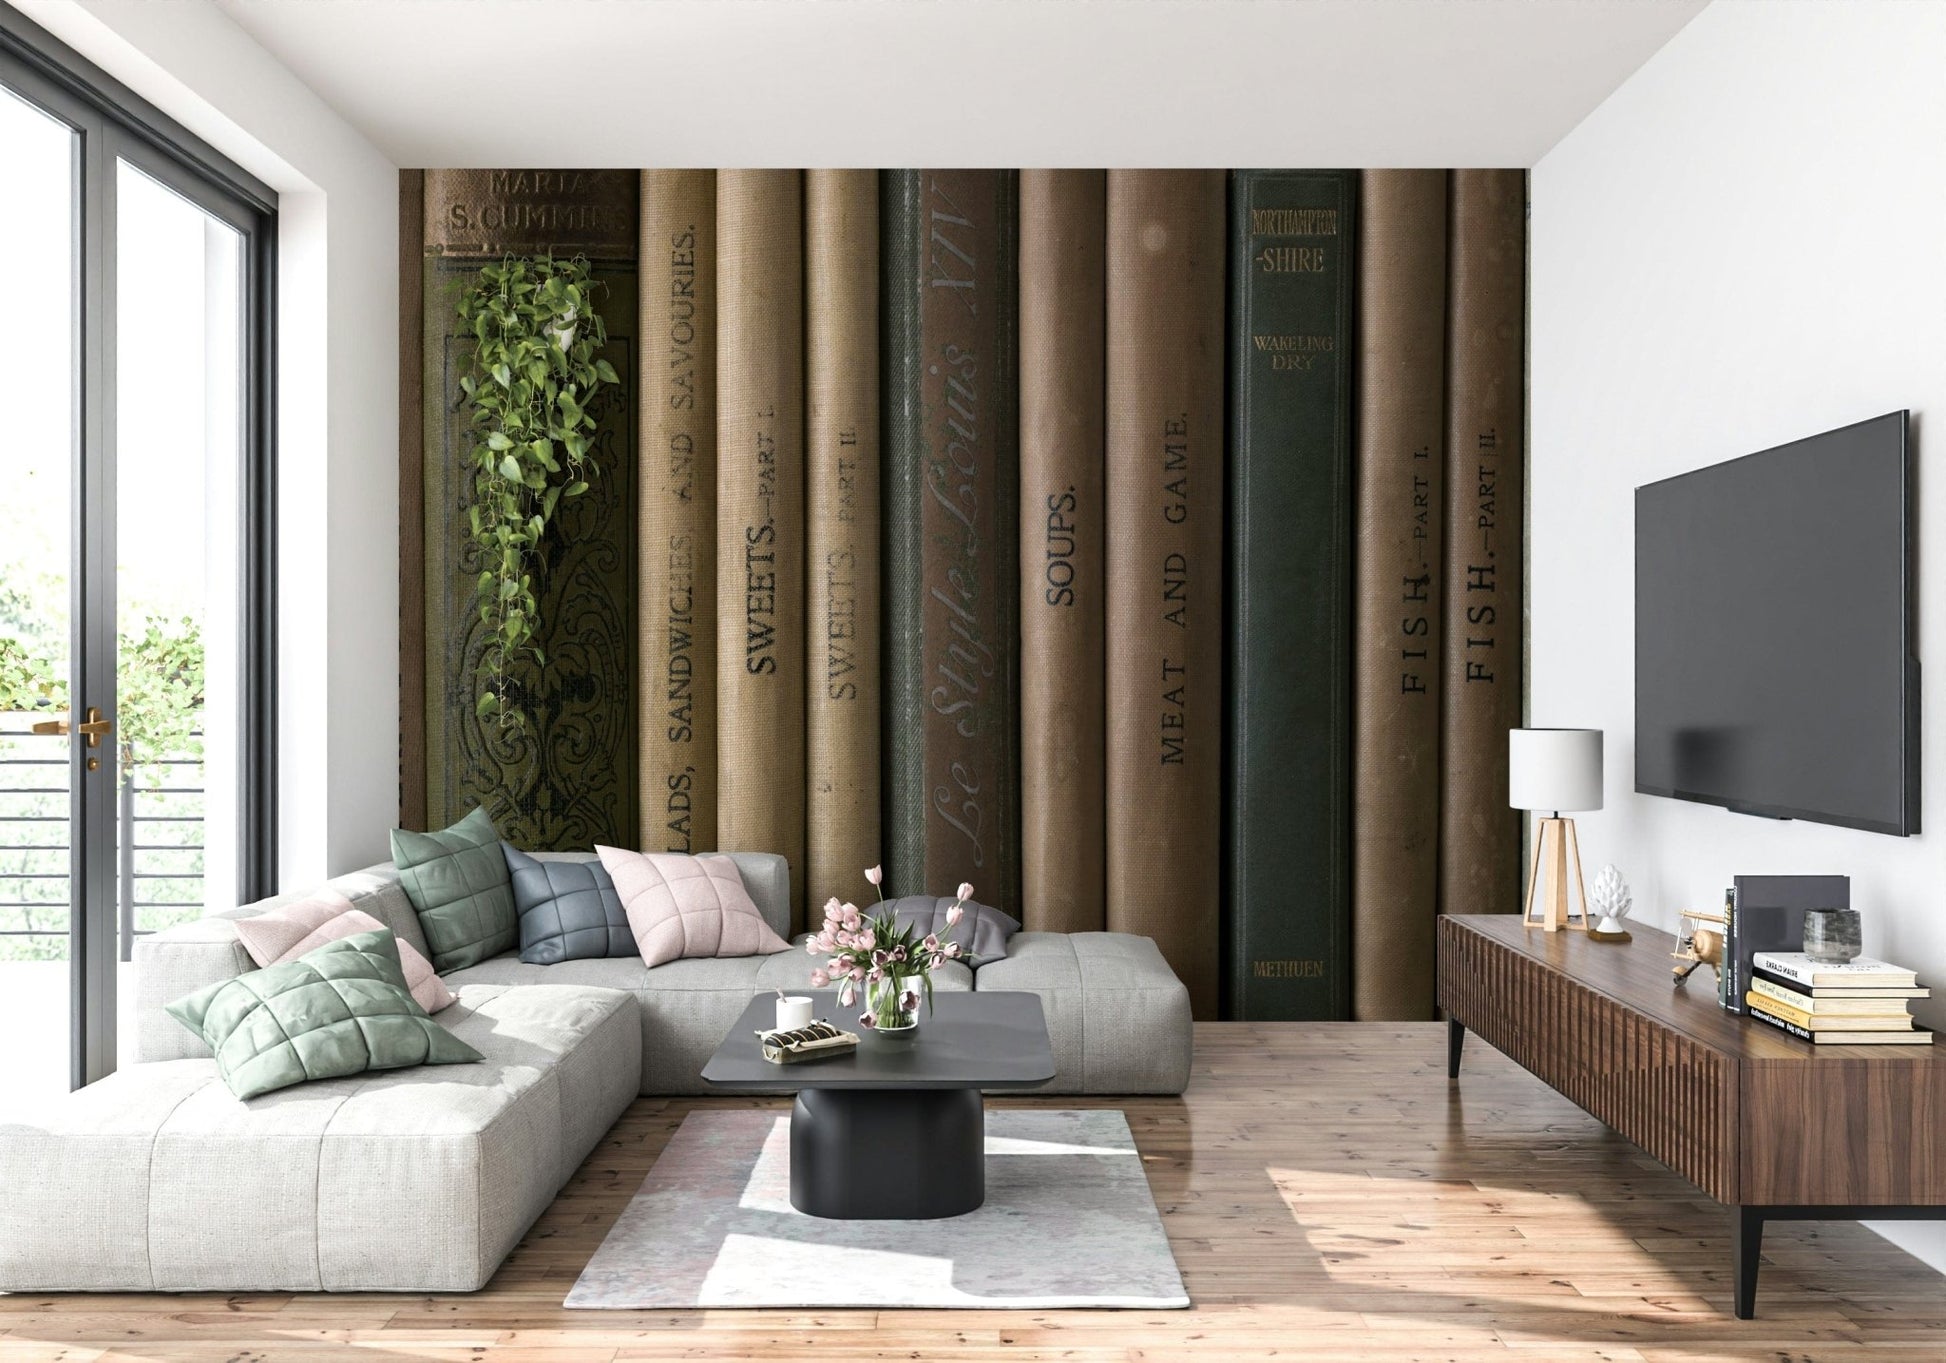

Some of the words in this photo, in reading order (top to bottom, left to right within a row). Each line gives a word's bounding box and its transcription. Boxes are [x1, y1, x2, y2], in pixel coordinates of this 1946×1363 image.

[931, 175, 977, 316] XIV
[1252, 209, 1337, 235] NORTHAMPTON
[671, 224, 696, 410] SAVOURIES.
[1254, 335, 1334, 352] WAKELING
[1272, 354, 1314, 370] DRY
[671, 433, 694, 502] AND
[927, 344, 978, 557] Louis
[1164, 412, 1188, 525] GAME.
[1046, 485, 1077, 607] SOUPS.
[1163, 553, 1187, 629] AND
[931, 567, 995, 738] Style
[1161, 658, 1186, 767] MEAT
[933, 762, 984, 868] Le
[1253, 960, 1324, 977] METHUEN
